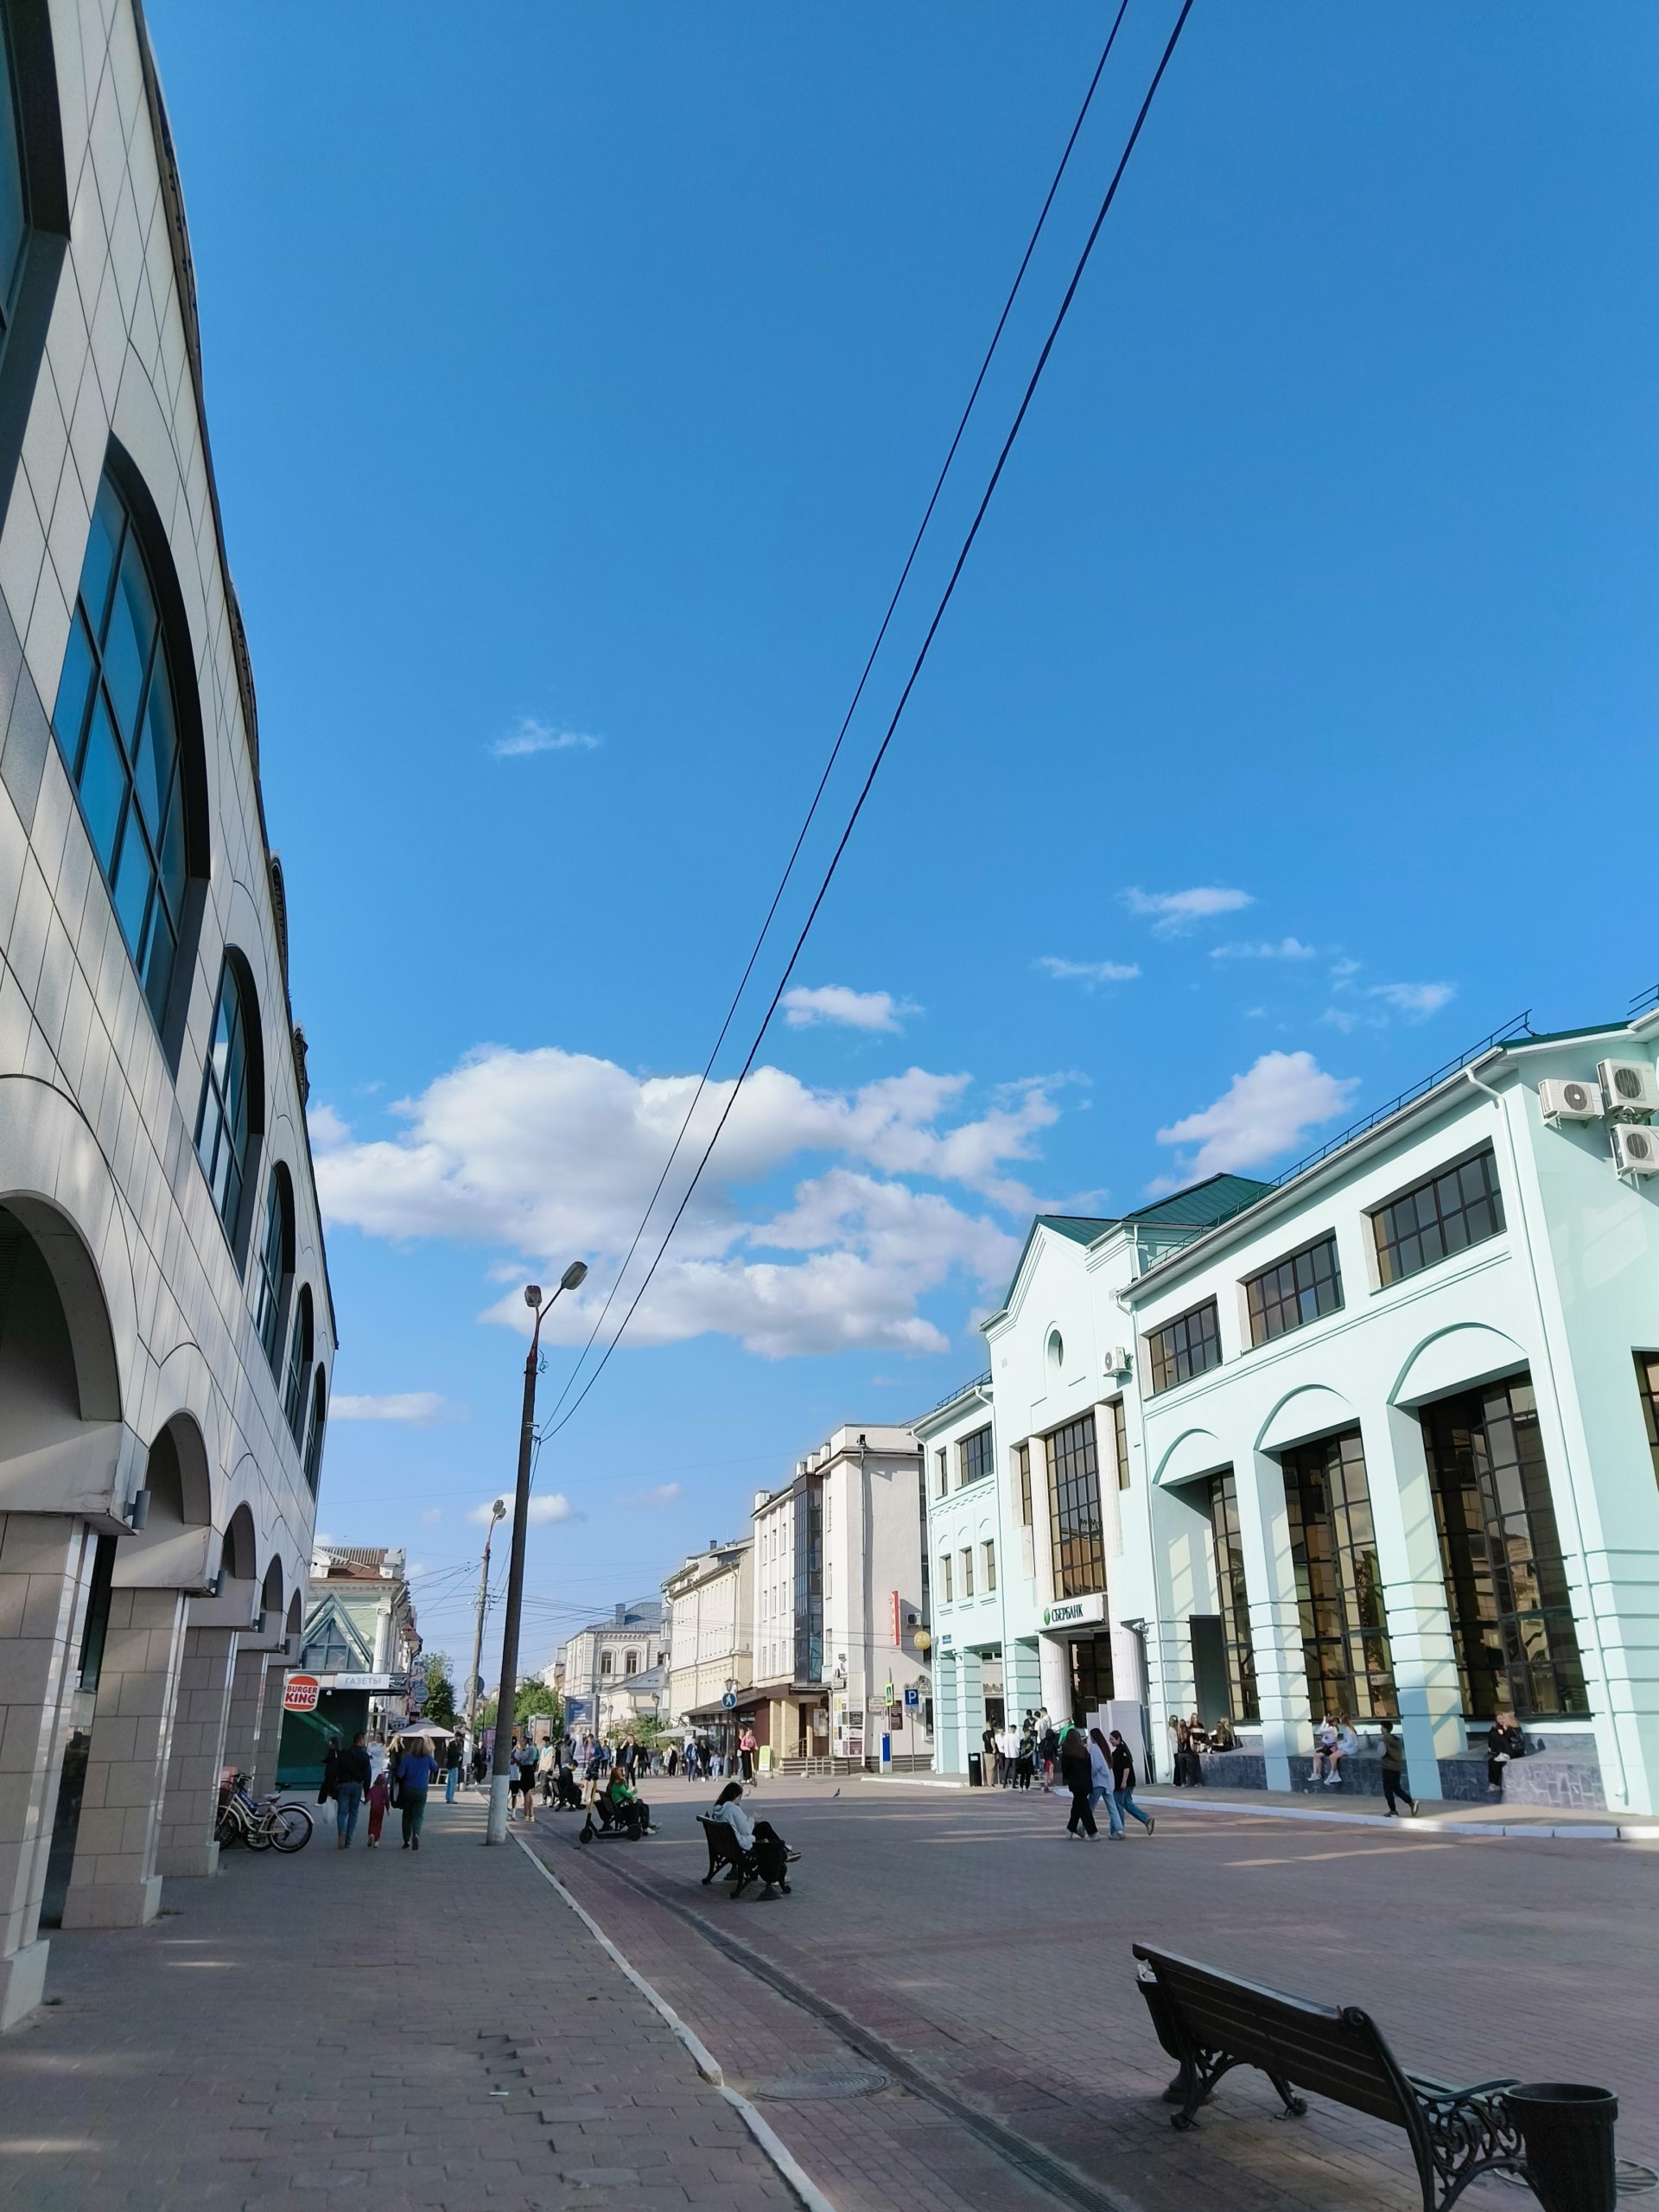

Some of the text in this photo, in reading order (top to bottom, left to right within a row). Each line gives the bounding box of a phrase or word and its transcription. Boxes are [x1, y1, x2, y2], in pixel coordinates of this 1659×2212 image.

[1052, 1604, 1084, 1622] СБЕРБАНК
[346, 1676, 381, 1685] ГАЗЕТЫ
[287, 1685, 318, 1695] BURGER
[285, 1693, 316, 1704] KING
[908, 1690, 917, 1704] P
